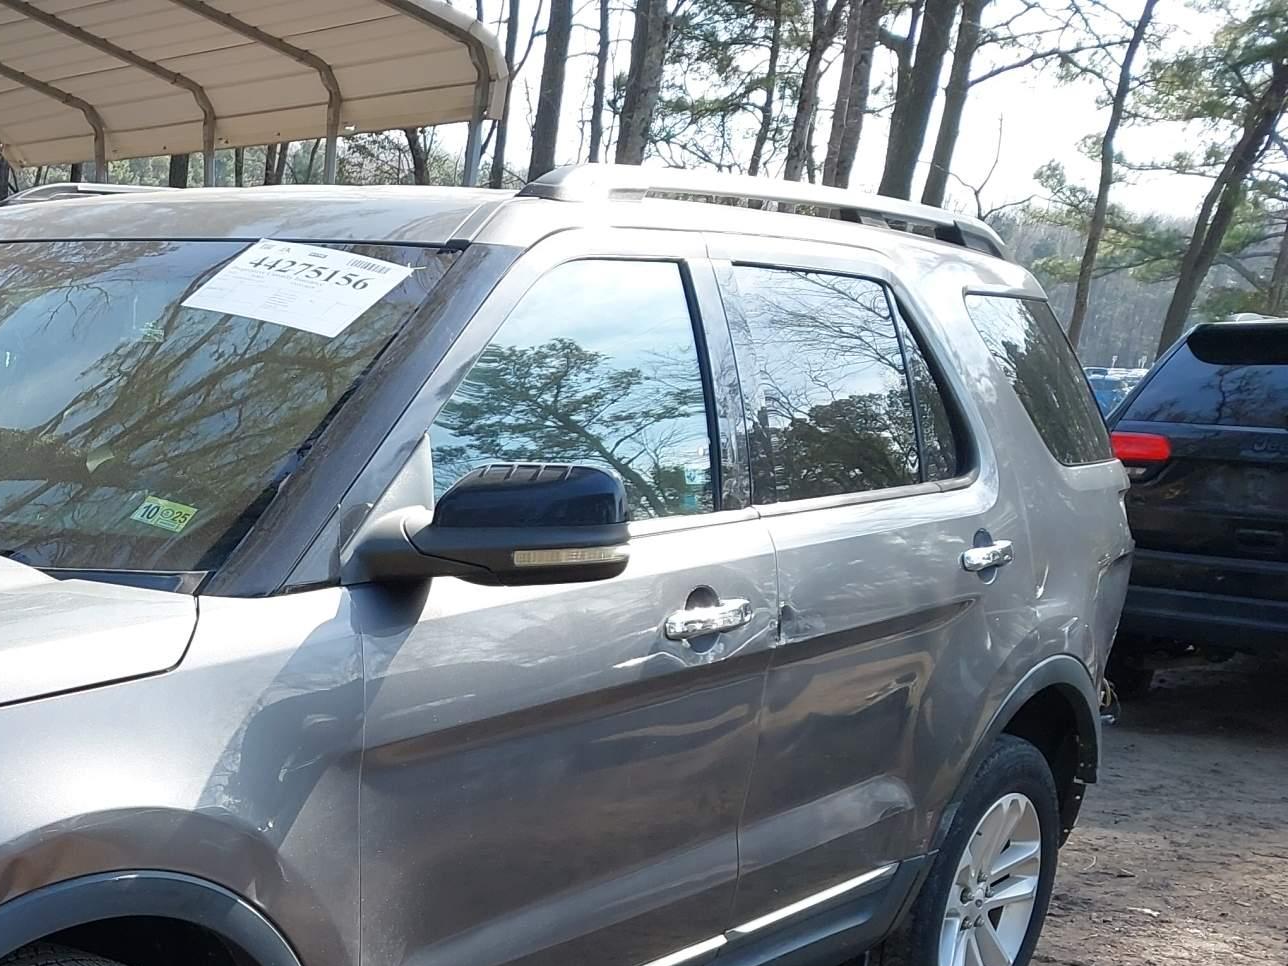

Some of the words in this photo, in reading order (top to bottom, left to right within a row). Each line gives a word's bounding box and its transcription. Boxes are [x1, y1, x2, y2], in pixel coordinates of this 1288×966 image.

[249, 255, 375, 291] 44275156
[140, 503, 160, 520] 10
[171, 511, 191, 524] 25
